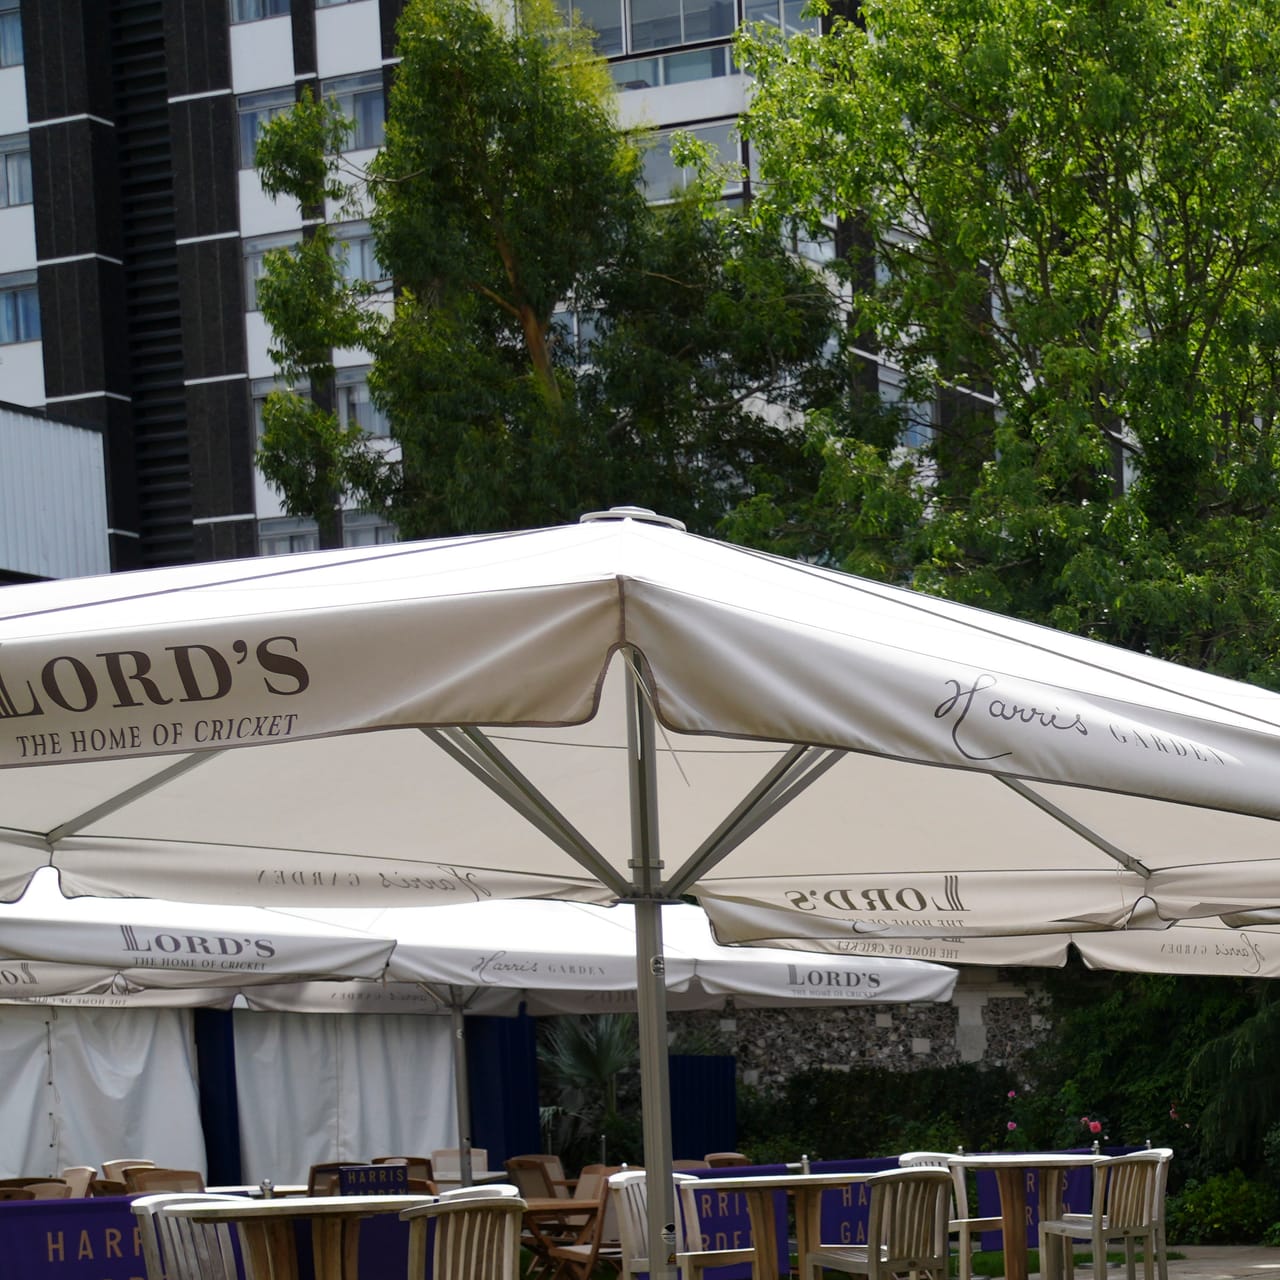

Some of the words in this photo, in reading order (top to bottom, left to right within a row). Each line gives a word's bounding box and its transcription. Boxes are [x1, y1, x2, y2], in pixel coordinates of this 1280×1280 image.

[934, 673, 1088, 760] Harris
[1109, 724, 1225, 765] GARDEN
[16, 732, 62, 758] THE
[71, 726, 142, 753] HOME
[152, 722, 184, 747] OF
[194, 714, 298, 743] CRICKET
[120, 925, 275, 958] LORD'S
[133, 957, 155, 967] THE
[162, 957, 196, 968] HOME
[201, 959, 217, 969] OF
[221, 960, 267, 971] CRICKET
[471, 951, 537, 983] Harris
[548, 964, 606, 976] GARDEN
[786, 964, 881, 988] LORD'S
[347, 1169, 404, 1184] HARRIS
